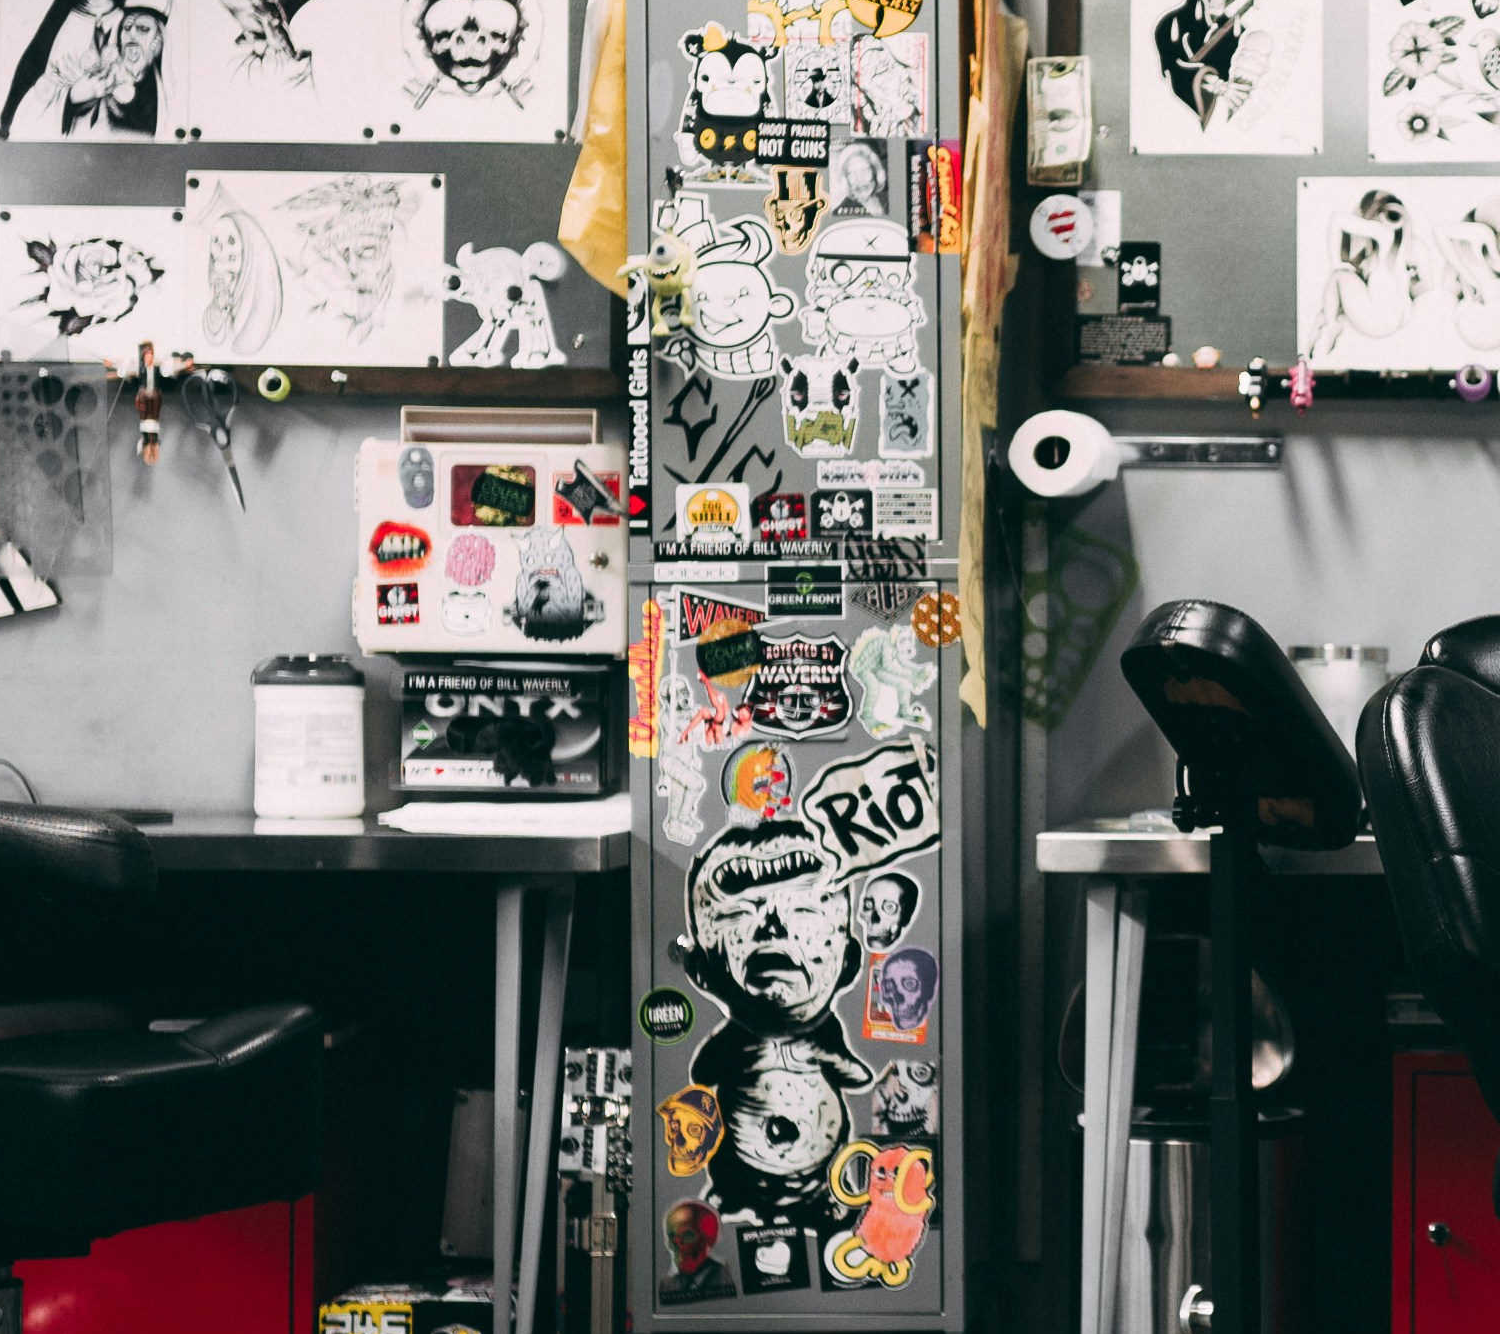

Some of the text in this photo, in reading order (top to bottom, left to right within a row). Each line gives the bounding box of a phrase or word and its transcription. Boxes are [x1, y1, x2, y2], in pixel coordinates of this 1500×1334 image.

[758, 122, 828, 139] SHOOT PRAYERS
[758, 139, 827, 159] NOT GUNS
[628, 347, 649, 397] Girls
[628, 399, 649, 489] Tattooed
[658, 542, 677, 556] I'M
[678, 542, 688, 556] A
[690, 541, 731, 556] FRIEND
[734, 541, 749, 556] OF
[752, 541, 778, 556] BILL
[768, 593, 842, 605] GREEN FRONT
[822, 643, 835, 660] BY
[408, 675, 427, 690] I'M
[428, 675, 436, 690] A
[438, 676, 477, 691] FRIEND
[480, 676, 494, 691] OF
[497, 676, 520, 691] BILL
[757, 666, 841, 684] WAVERLY
[425, 692, 581, 719] ONYX
[648, 1002, 684, 1024] GREEN
